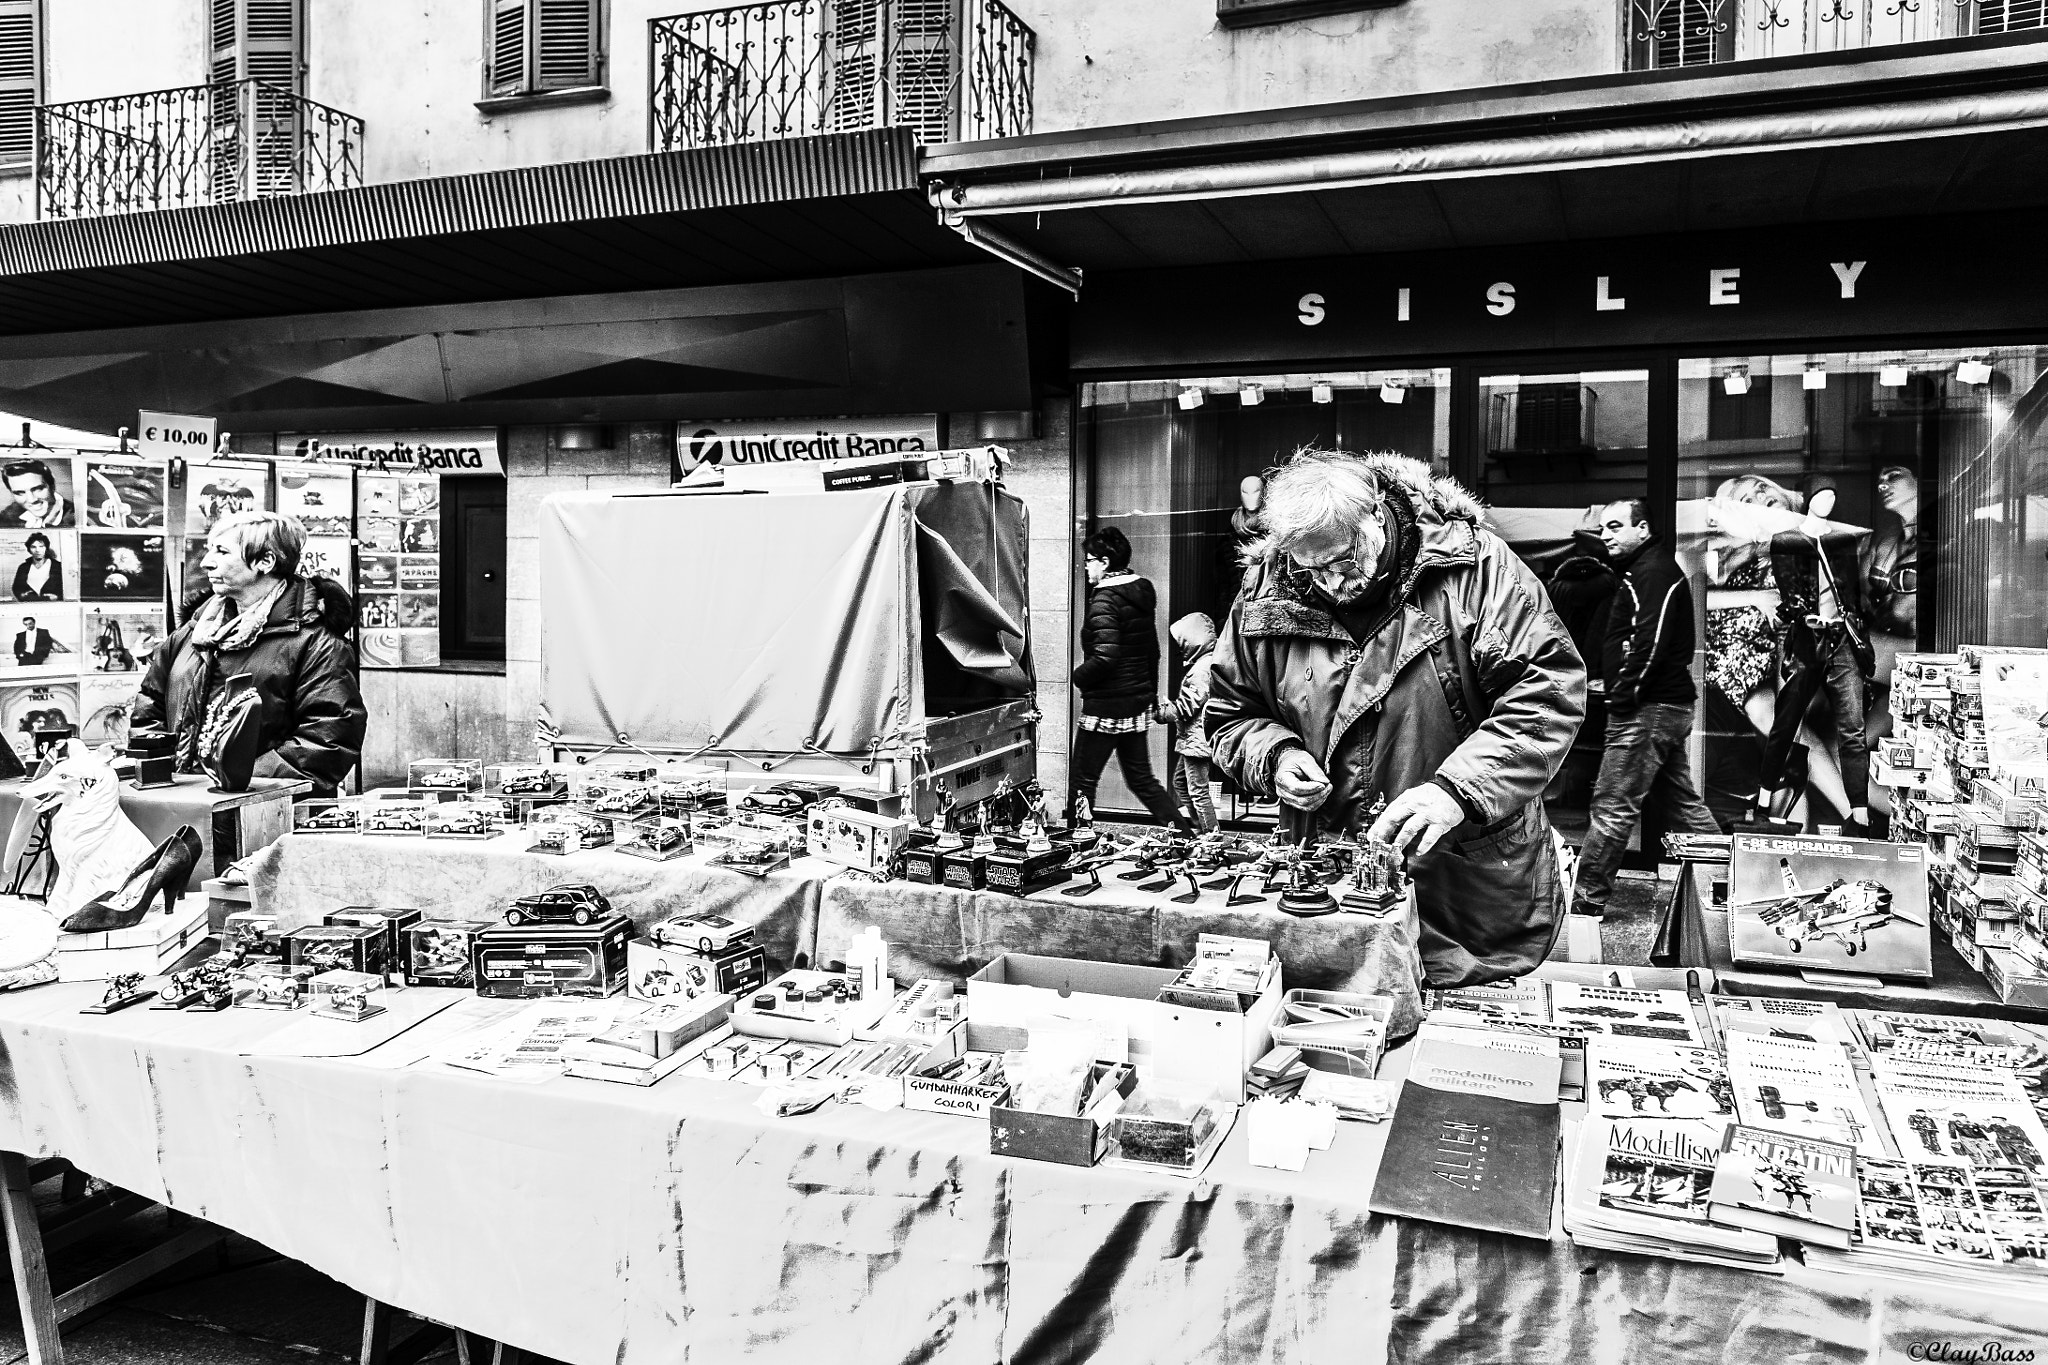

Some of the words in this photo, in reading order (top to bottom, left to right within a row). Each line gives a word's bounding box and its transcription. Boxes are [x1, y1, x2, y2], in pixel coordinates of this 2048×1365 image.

[1298, 260, 1867, 326] SISLEY
[145, 427, 157, 441] €
[162, 428, 208, 446] 10,00
[730, 431, 839, 463] UniCredit
[846, 434, 925, 458] Banca
[421, 446, 483, 470] Banca
[1771, 839, 1853, 854] CRUSADER
[945, 864, 970, 874] STAR
[945, 872, 971, 882] WARS
[986, 864, 1019, 877] STAR
[986, 874, 1021, 887] WARS
[896, 984, 929, 1014] milliput
[1872, 1014, 1986, 1031] AVIATORI
[1892, 1037, 1957, 1057] STAR
[1962, 1043, 2024, 1063] TREK
[1428, 1075, 1497, 1091] militare
[1431, 1067, 1534, 1088] modellismo
[934, 1097, 980, 1112] COLORI
[1431, 1120, 1479, 1189] ALIEN
[1730, 1136, 1853, 1178] SOLDATINI
